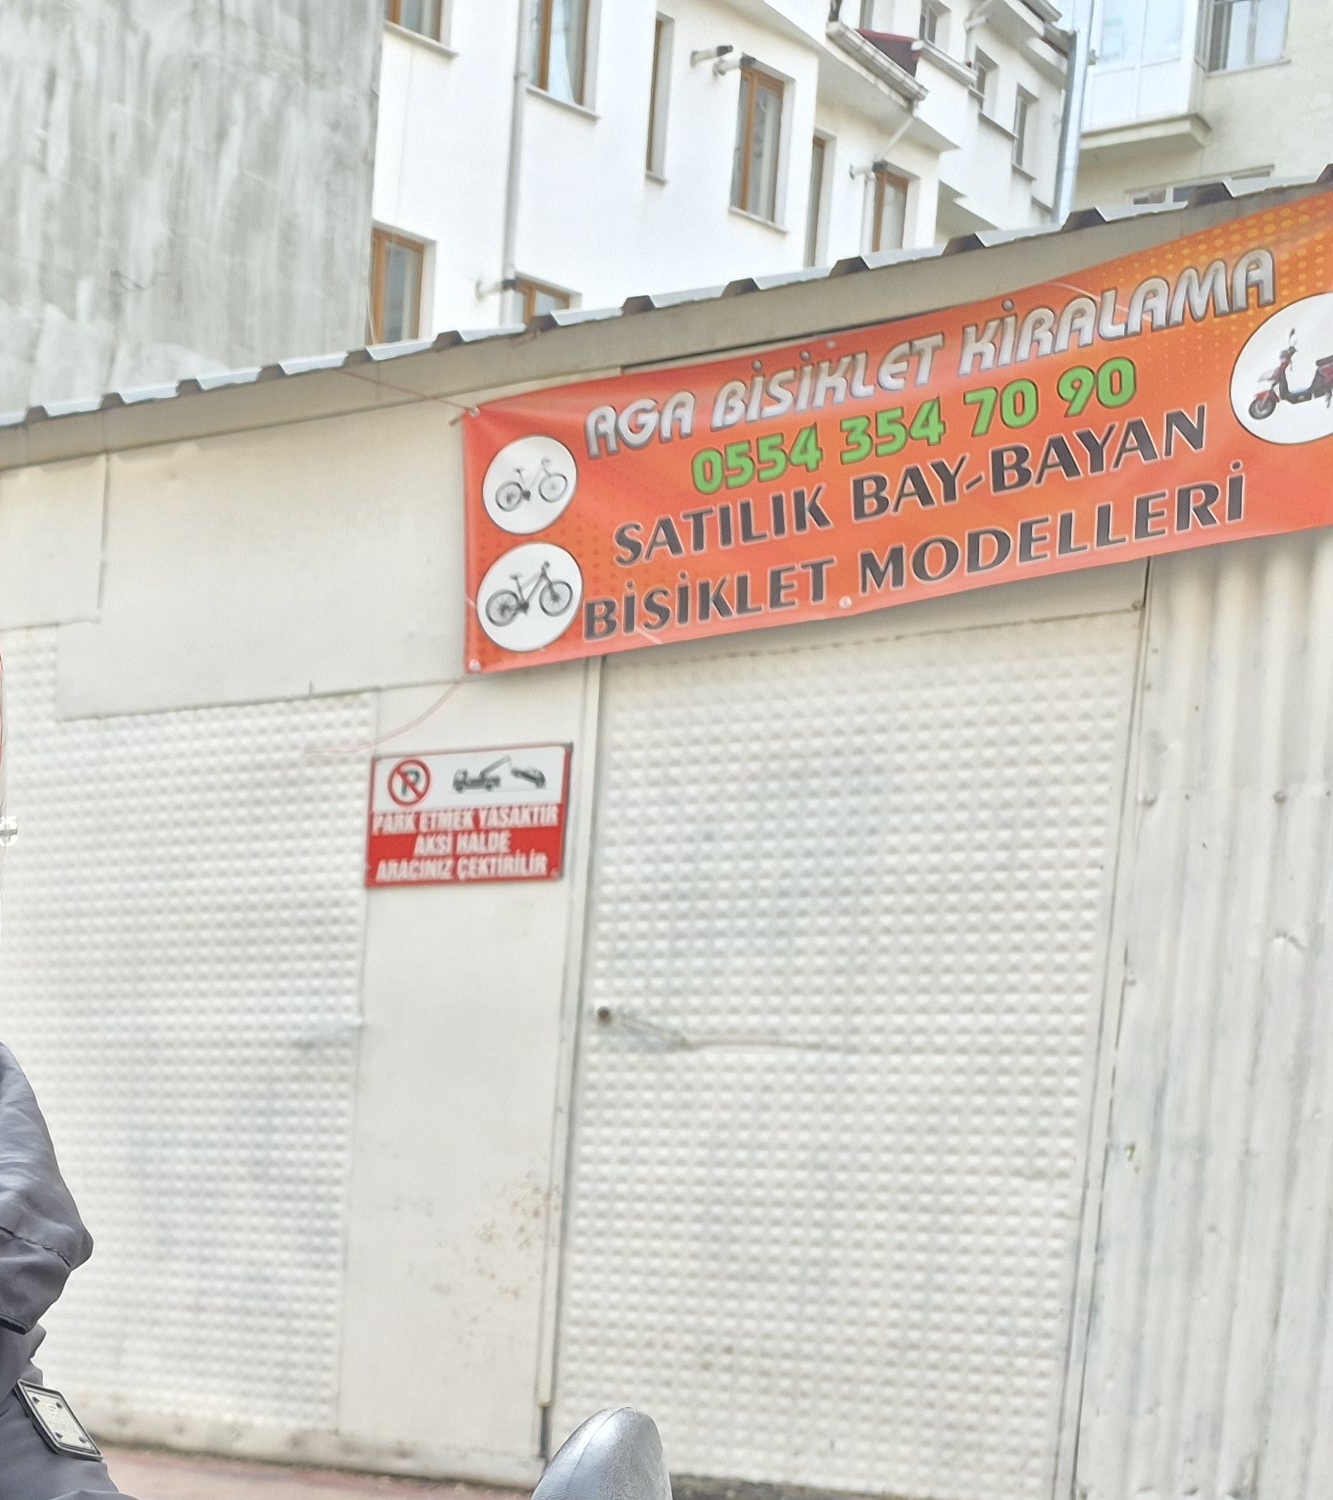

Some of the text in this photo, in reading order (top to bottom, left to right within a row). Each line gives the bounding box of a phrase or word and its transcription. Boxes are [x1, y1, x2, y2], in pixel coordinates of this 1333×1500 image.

[585, 249, 1276, 459] AGA BİSİKLET KİRALAMA
[692, 357, 1138, 494] 0554 354 70 90
[584, 461, 1245, 641] BİSİKLET MODELLERİ
[614, 404, 1206, 567] SATILIK BAY-BAYAN
[372, 812, 417, 836] PARK
[420, 808, 475, 833] ETMEK
[456, 830, 512, 855] HALDE
